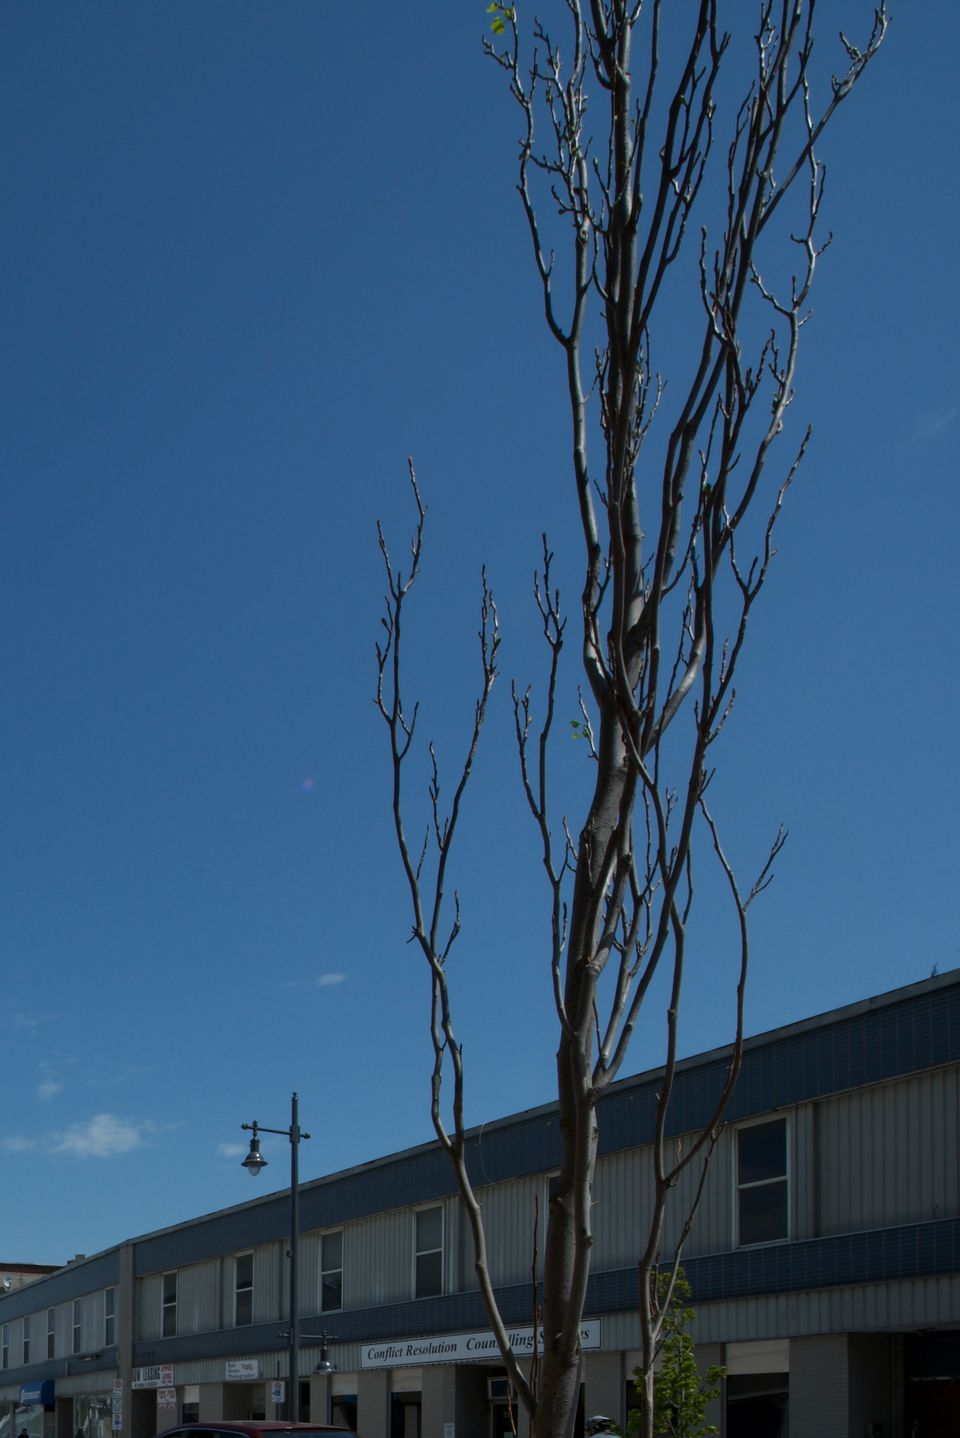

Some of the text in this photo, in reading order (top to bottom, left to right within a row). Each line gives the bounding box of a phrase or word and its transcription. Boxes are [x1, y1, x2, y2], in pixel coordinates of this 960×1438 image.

[367, 1346, 403, 1362] Conflict
[406, 1341, 457, 1357] Resolution
[466, 1332, 533, 1351] Counlling
